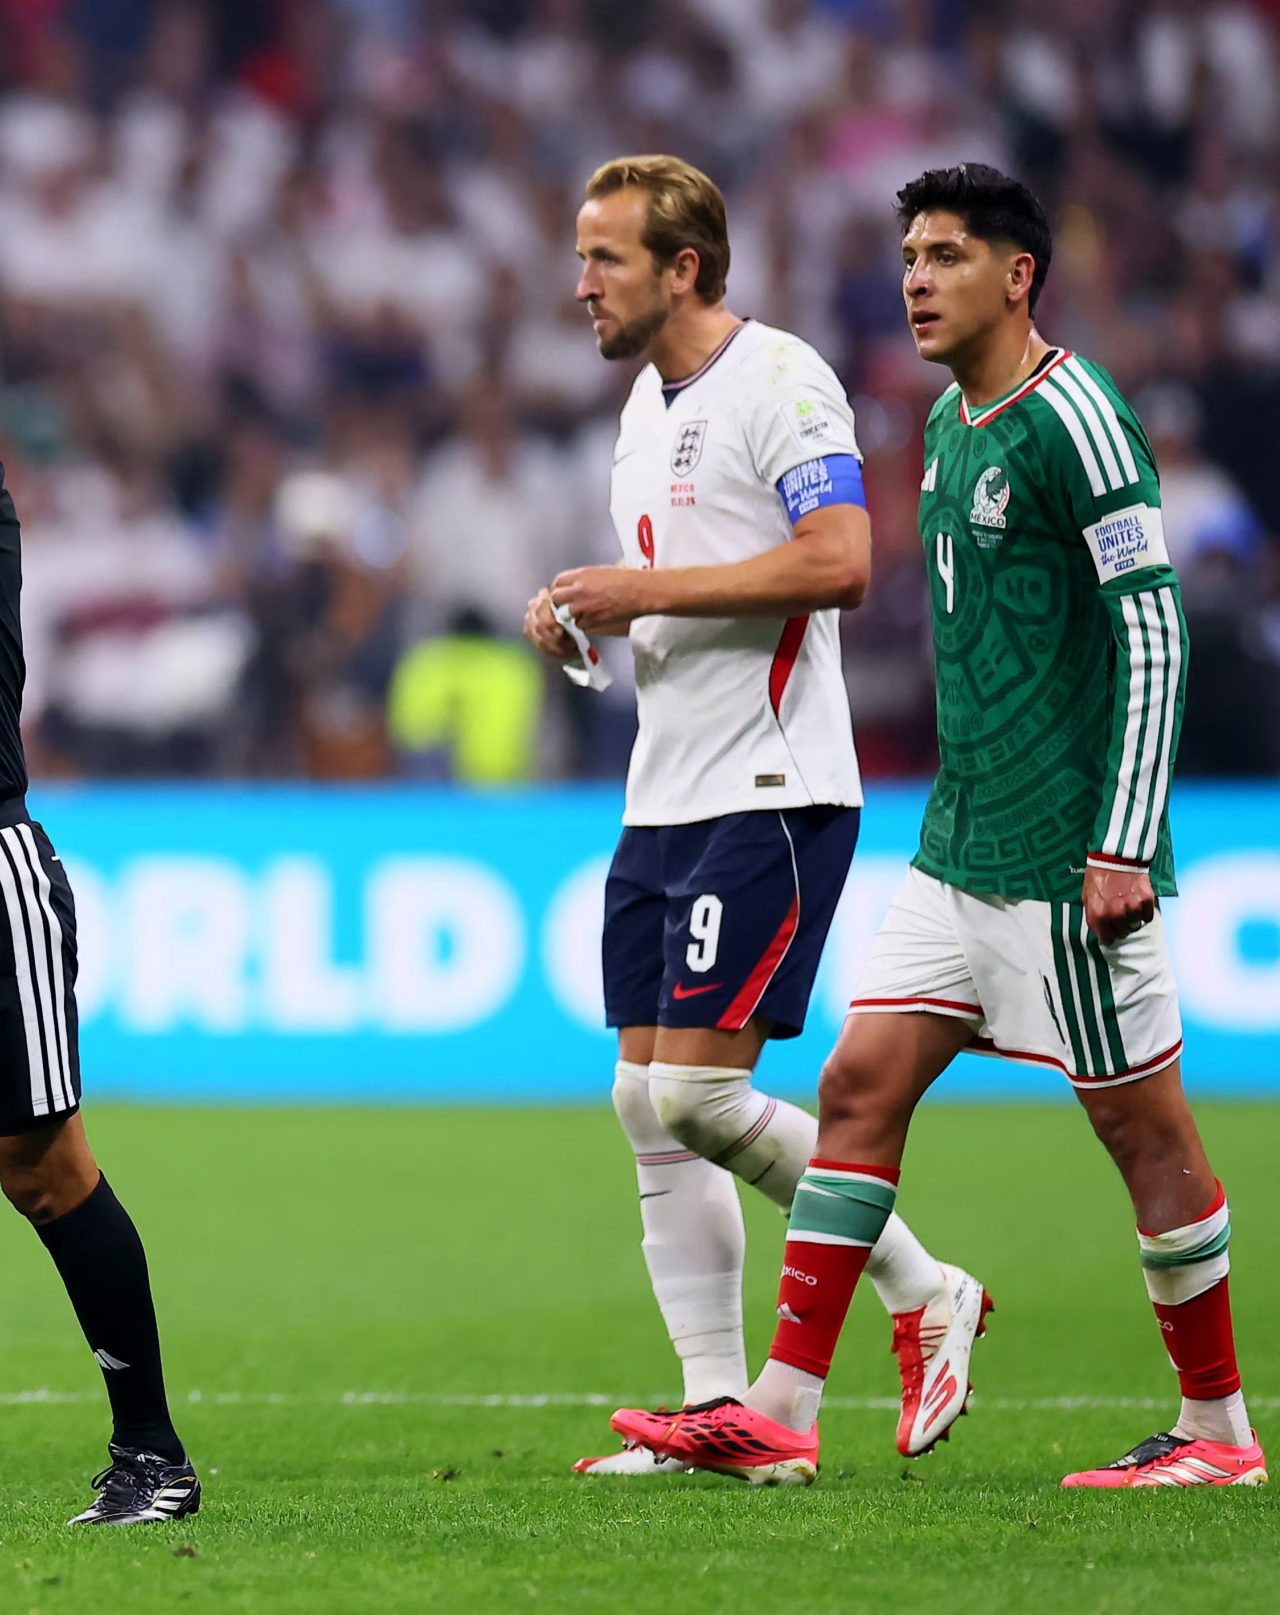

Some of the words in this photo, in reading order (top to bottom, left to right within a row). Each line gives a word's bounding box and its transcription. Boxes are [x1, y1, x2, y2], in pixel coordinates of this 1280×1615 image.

[783, 468, 828, 498] UNITES
[1095, 516, 1141, 539] FOOTBALL
[1098, 526, 1144, 552] UNITES
[638, 514, 654, 570] 9
[1101, 552, 1116, 566] the
[1117, 540, 1148, 560] World
[937, 532, 954, 614] 4
[1116, 558, 1134, 571] FIFA
[686, 893, 723, 973] 9
[781, 1265, 818, 1286] XICO
